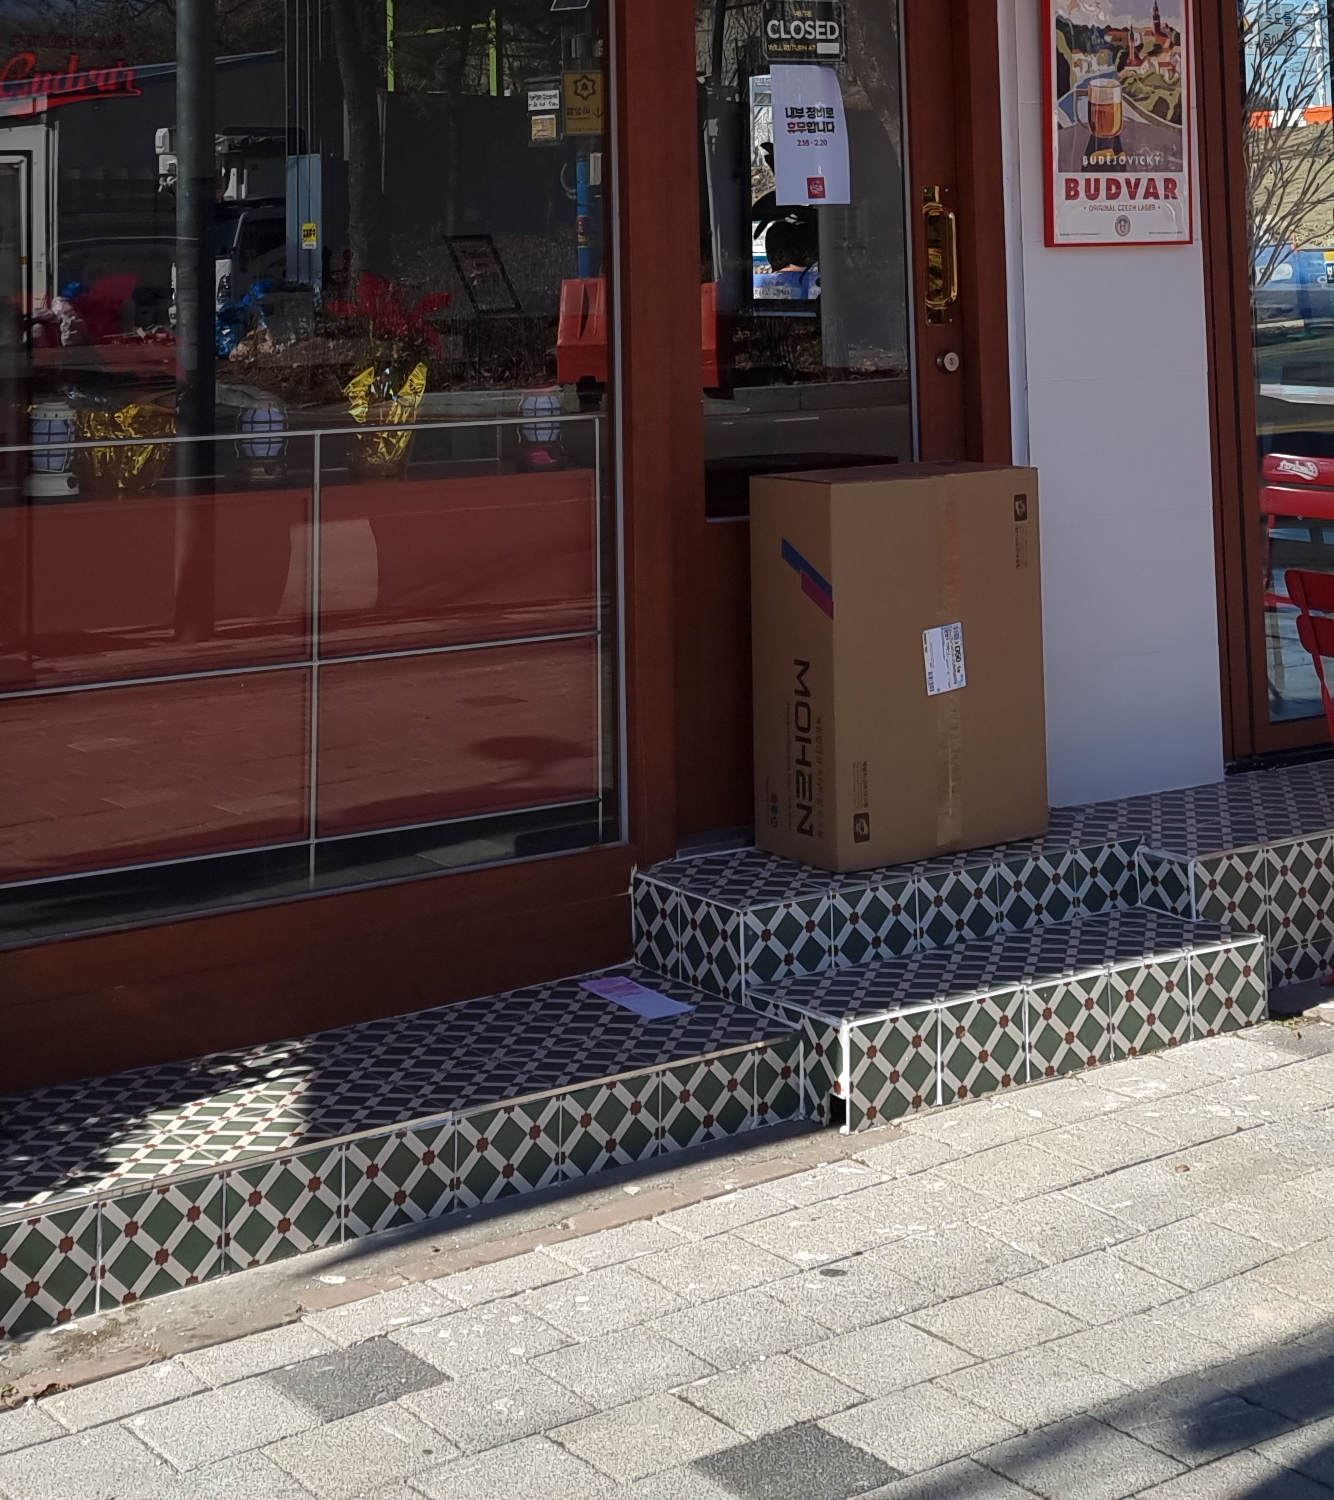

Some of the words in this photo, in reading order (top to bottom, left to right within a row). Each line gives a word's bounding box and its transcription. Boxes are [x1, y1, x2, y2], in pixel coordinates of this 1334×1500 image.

[767, 19, 839, 39] CLOSED
[785, 106, 805, 119] 내부
[787, 121, 835, 134] 휴무입니다
[1064, 177, 1179, 201] BUDVAR
[794, 659, 814, 837] MOHEN
